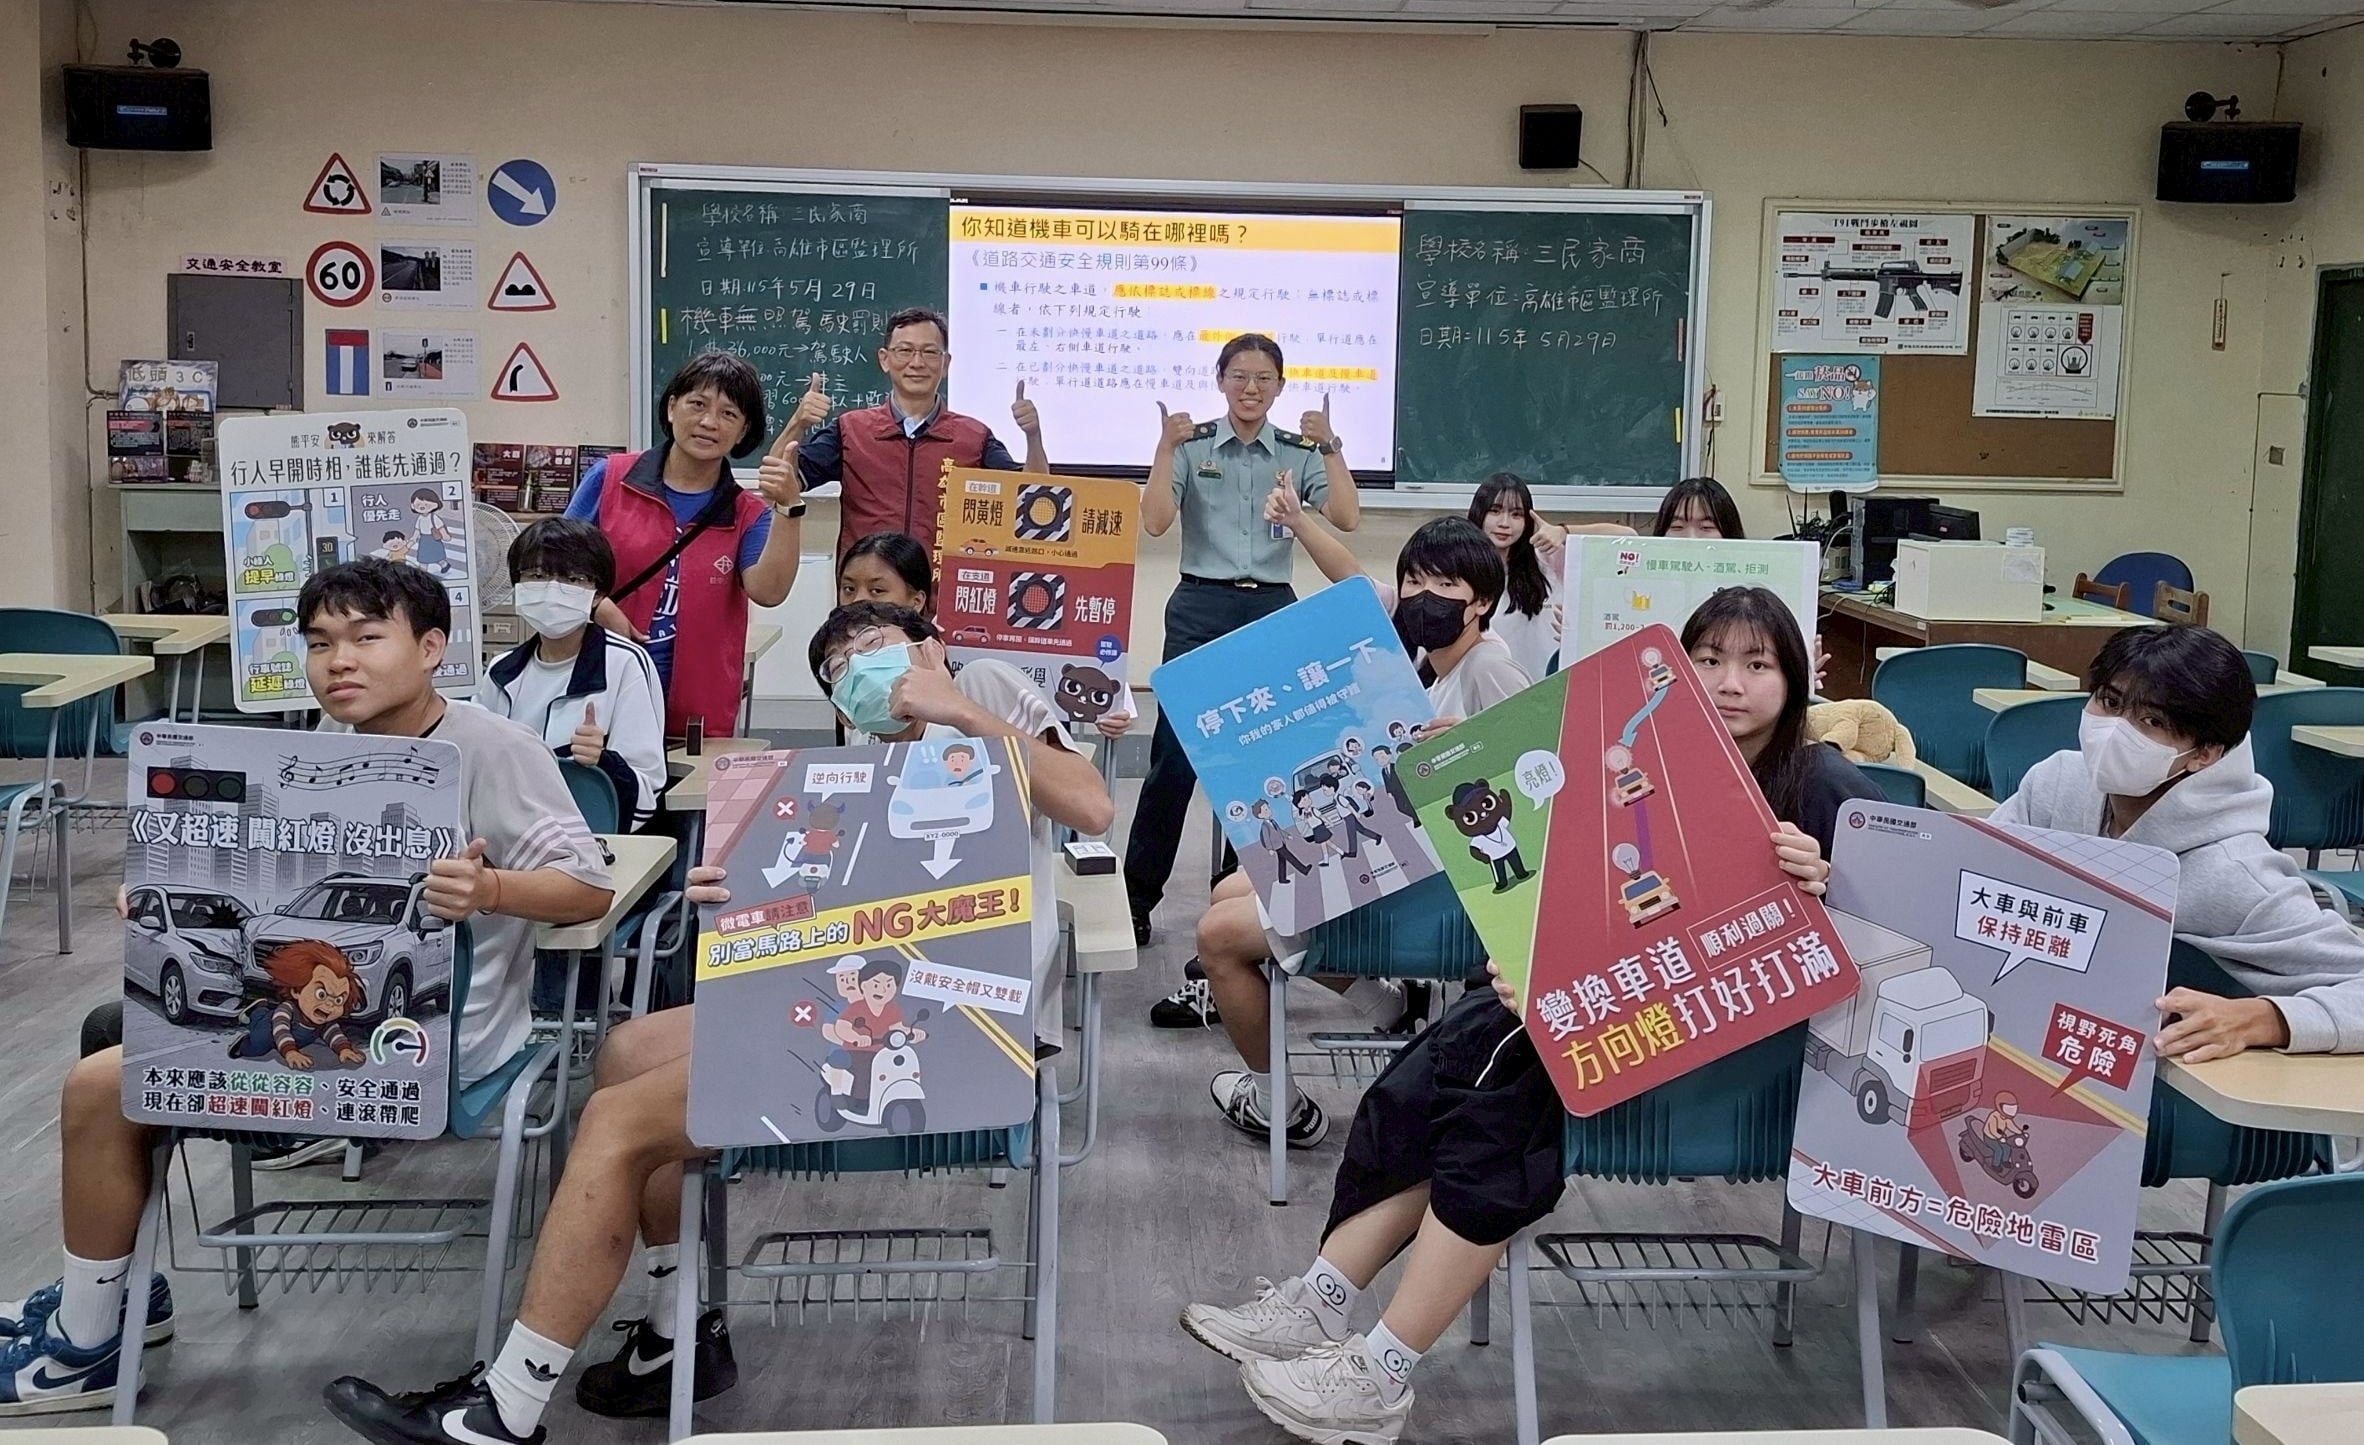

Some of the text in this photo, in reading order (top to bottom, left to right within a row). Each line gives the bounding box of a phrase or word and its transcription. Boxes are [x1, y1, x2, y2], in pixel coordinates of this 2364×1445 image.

[962, 216, 1247, 243] 你知道機車可以騎在哪裡嗎？
[186, 258, 283, 274] 交通安全教室
[319, 262, 361, 291] 60
[970, 250, 1200, 273] 《道路交通安全規則第99條》
[291, 430, 397, 449] 熊平安 來解答
[230, 451, 462, 486] 行人早開時相，誰能先通過？
[330, 492, 338, 503] 1
[361, 493, 388, 507] 行人
[448, 486, 457, 496] 2
[363, 508, 401, 524] 優先走
[963, 498, 1004, 528] 閃黃燈
[1081, 507, 1124, 537] 請減速
[321, 542, 334, 554] 30
[1620, 552, 1639, 563] NO!
[962, 570, 991, 582] 在支道
[454, 592, 463, 601] 4
[955, 586, 998, 616] 閃紅燈
[1074, 596, 1117, 626] 先暫停
[1196, 637, 1378, 739] 停下來、讓一下
[811, 771, 867, 786] 逆向行駛
[1522, 760, 1559, 791] 亮燈！
[129, 810, 454, 861] 《又超速 闖紅燈 沒出息》
[1971, 885, 2089, 934] 大車與前車
[1700, 898, 1798, 958] 順利過關！
[1976, 914, 2072, 960] 保持距離
[909, 969, 1024, 1005] 沒戴安全帽又雙載
[1536, 936, 1697, 1042] 變換車道
[1561, 930, 1841, 1091] 方向燈打好打滿
[2056, 1010, 2139, 1056] 視野死角
[2056, 1037, 2118, 1078] 危險
[143, 1066, 421, 1102] 本來應該從從容容、安全通過
[142, 1089, 420, 1127] 現在卻超速闖紅燈、連滾帶爬
[1810, 1163, 2101, 1266] 大車前方=危險地雷區
